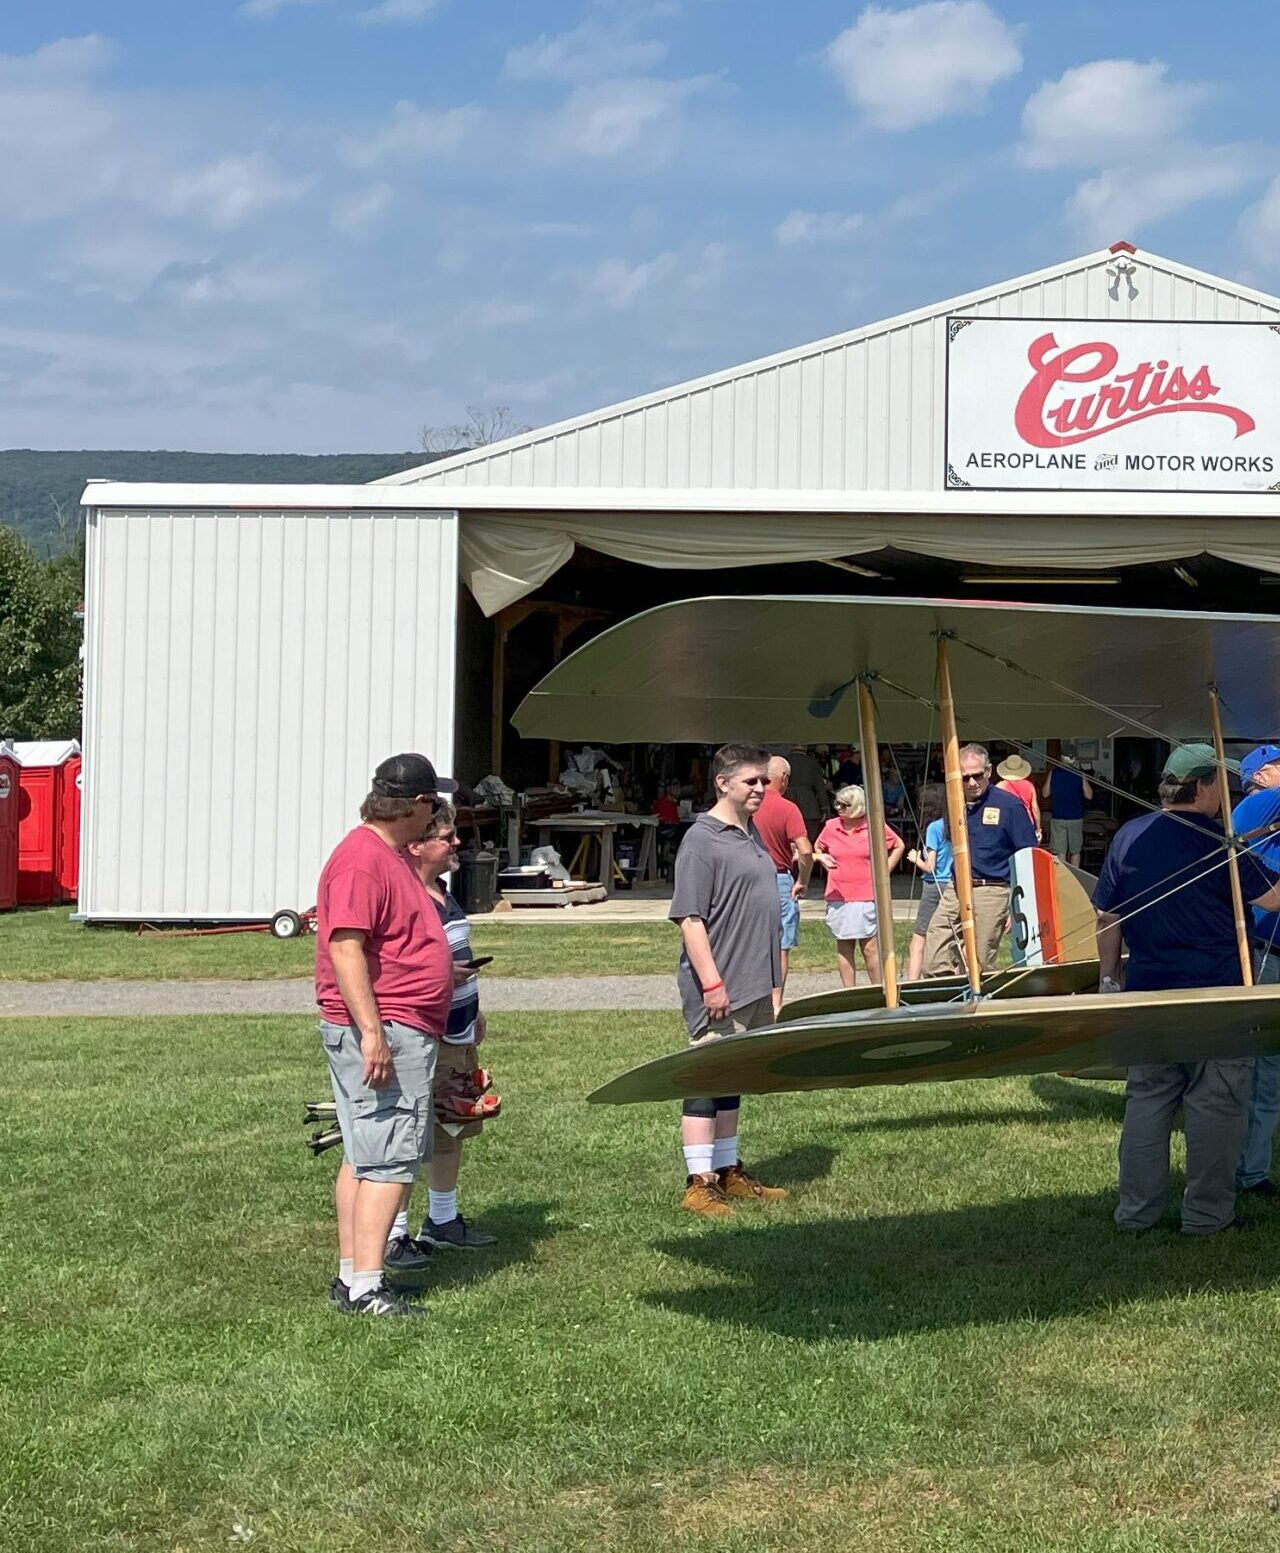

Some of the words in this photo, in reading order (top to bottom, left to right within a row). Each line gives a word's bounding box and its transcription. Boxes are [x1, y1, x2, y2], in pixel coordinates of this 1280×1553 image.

[1014, 332, 1255, 448] Curtiss
[966, 452, 1086, 469] AEROPLANE
[1125, 455, 1195, 470] MOTOR
[1201, 456, 1274, 472] WORKS
